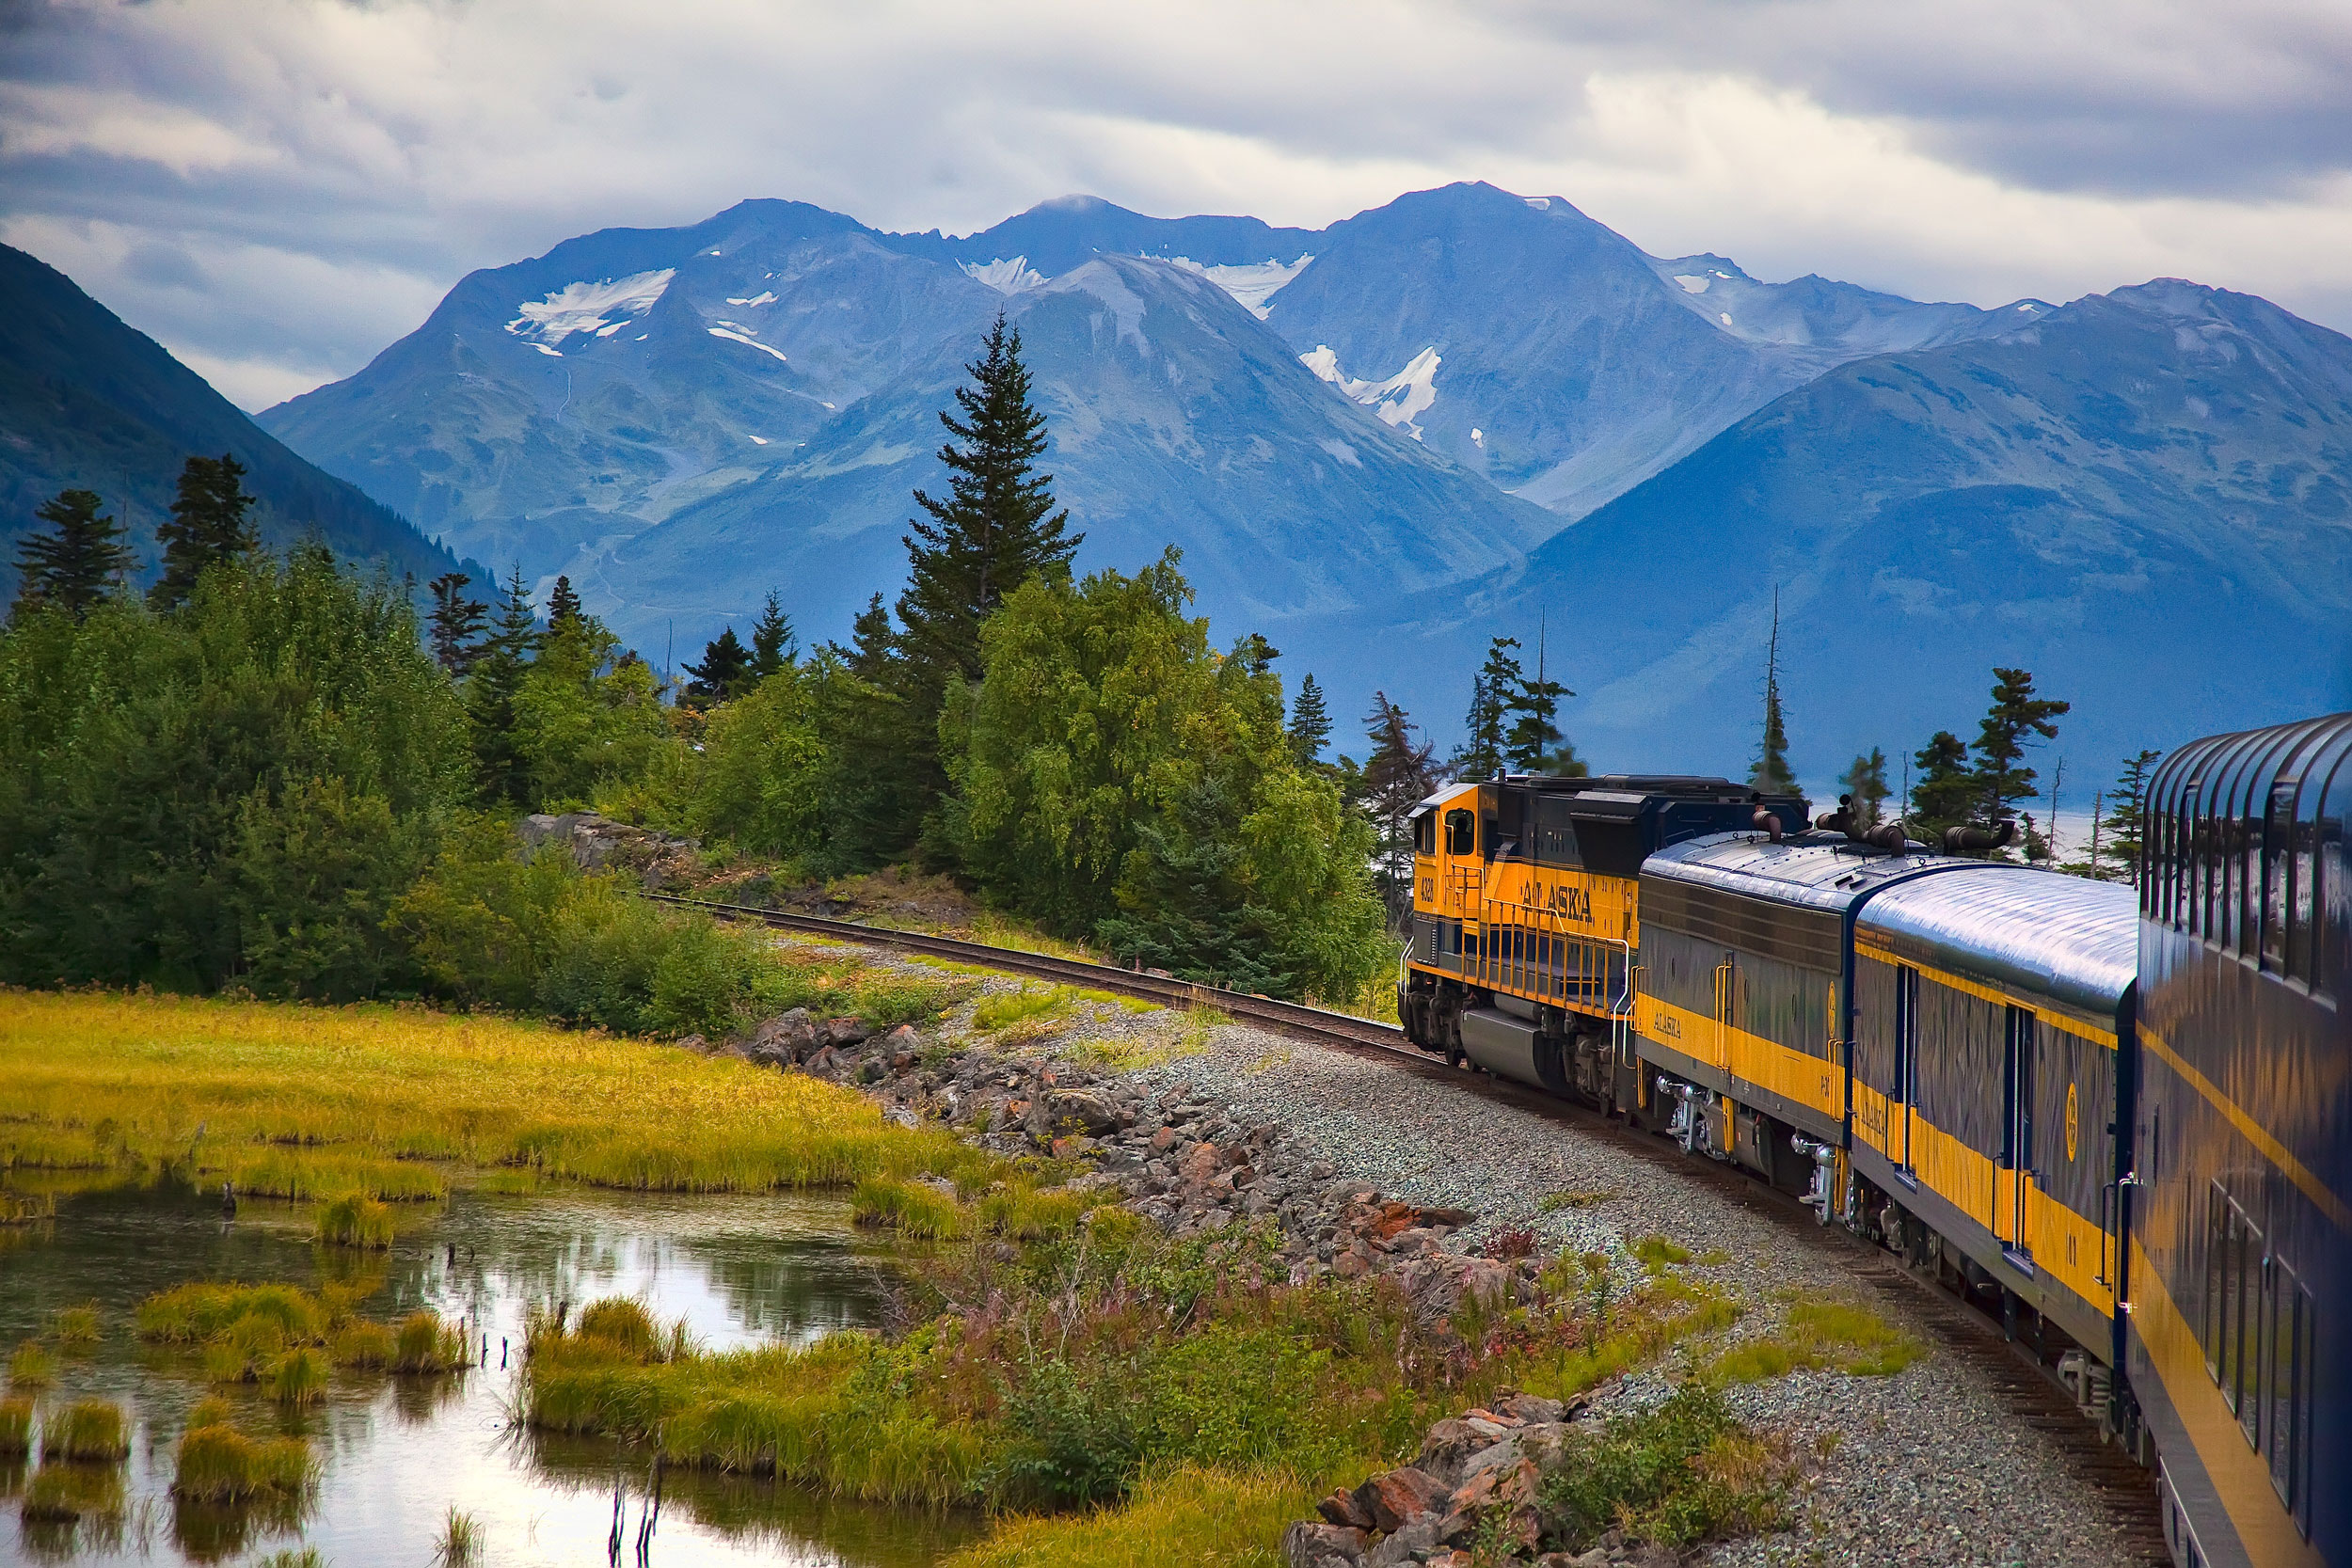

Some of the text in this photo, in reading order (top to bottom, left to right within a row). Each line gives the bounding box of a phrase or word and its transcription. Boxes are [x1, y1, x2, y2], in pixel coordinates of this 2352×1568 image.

[1520, 877, 1593, 924] ALASKA
[1654, 1012, 1682, 1039] ALASKA
[1861, 1101, 1885, 1137] ALASKA
